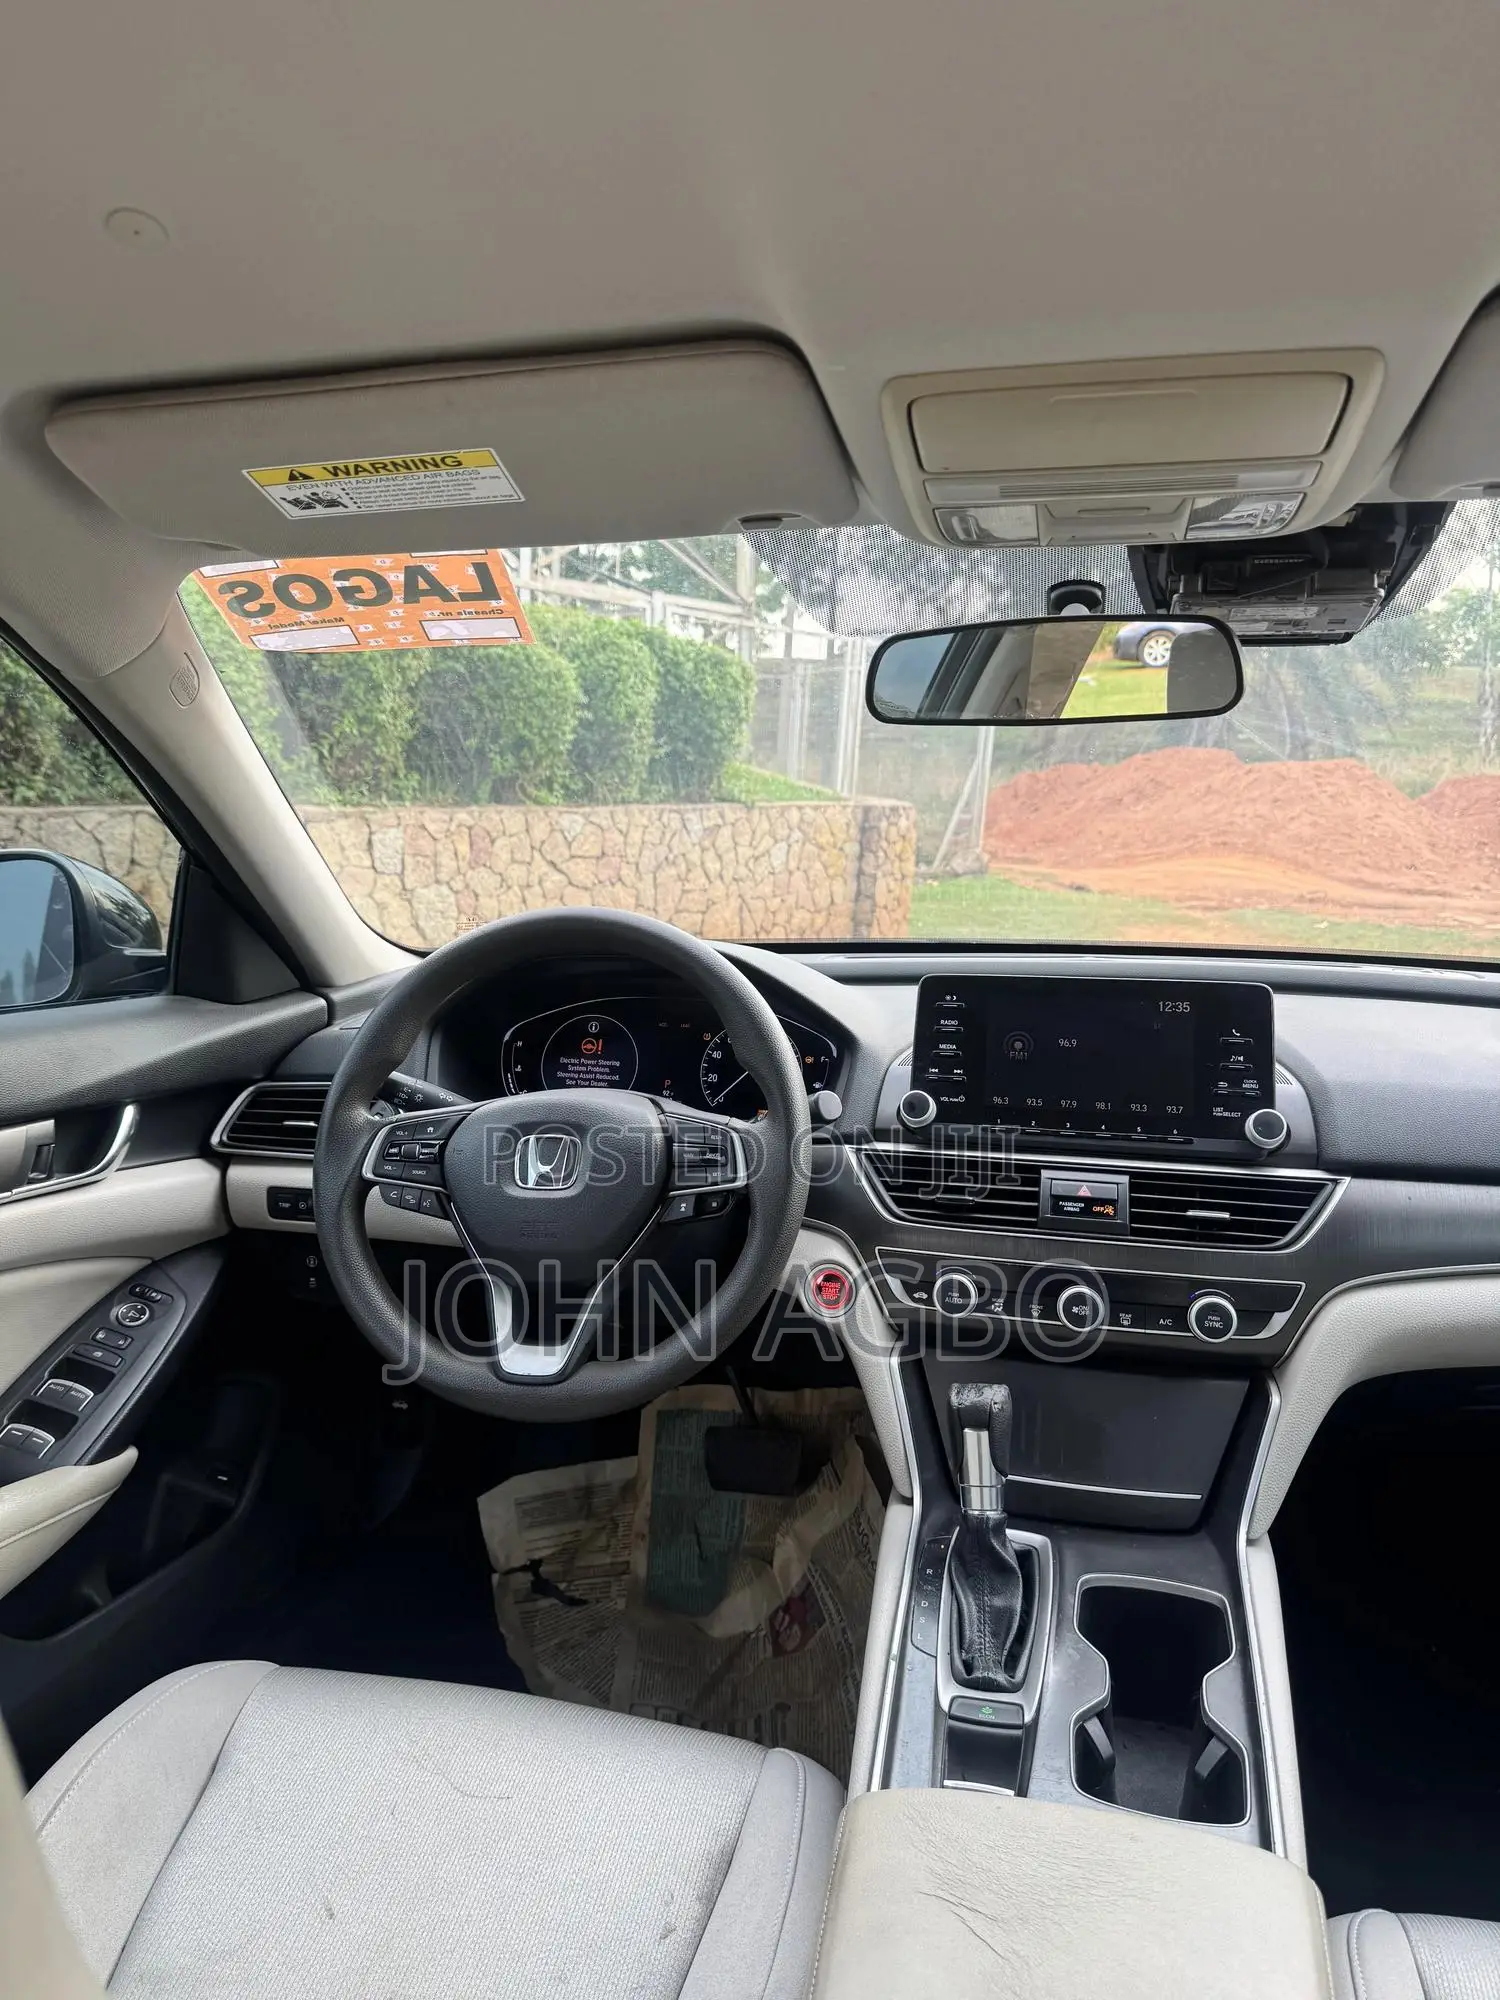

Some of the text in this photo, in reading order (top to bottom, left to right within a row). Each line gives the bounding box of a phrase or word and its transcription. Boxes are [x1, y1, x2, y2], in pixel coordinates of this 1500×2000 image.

[322, 455, 463, 478] WARNING
[287, 469, 480, 492] EVEN WITH ADVANCED AIR BAGS
[1158, 1001, 1191, 1012] 12:35
[1058, 1038, 1077, 1047] 96.9
[711, 1050, 722, 1059] 40
[1009, 1051, 1028, 1060] FM1
[560, 1056, 579, 1064] Electric
[598, 1059, 620, 1067] Steering
[707, 1073, 718, 1082] 20
[664, 1079, 671, 1088] P
[993, 1096, 1184, 1114] 96.3 93.5 97.9 98.1 93.3 93.7
[1159, 1318, 1172, 1326] A/C
[1204, 1320, 1224, 1329] SYNC
[917, 1632, 923, 1640] L
